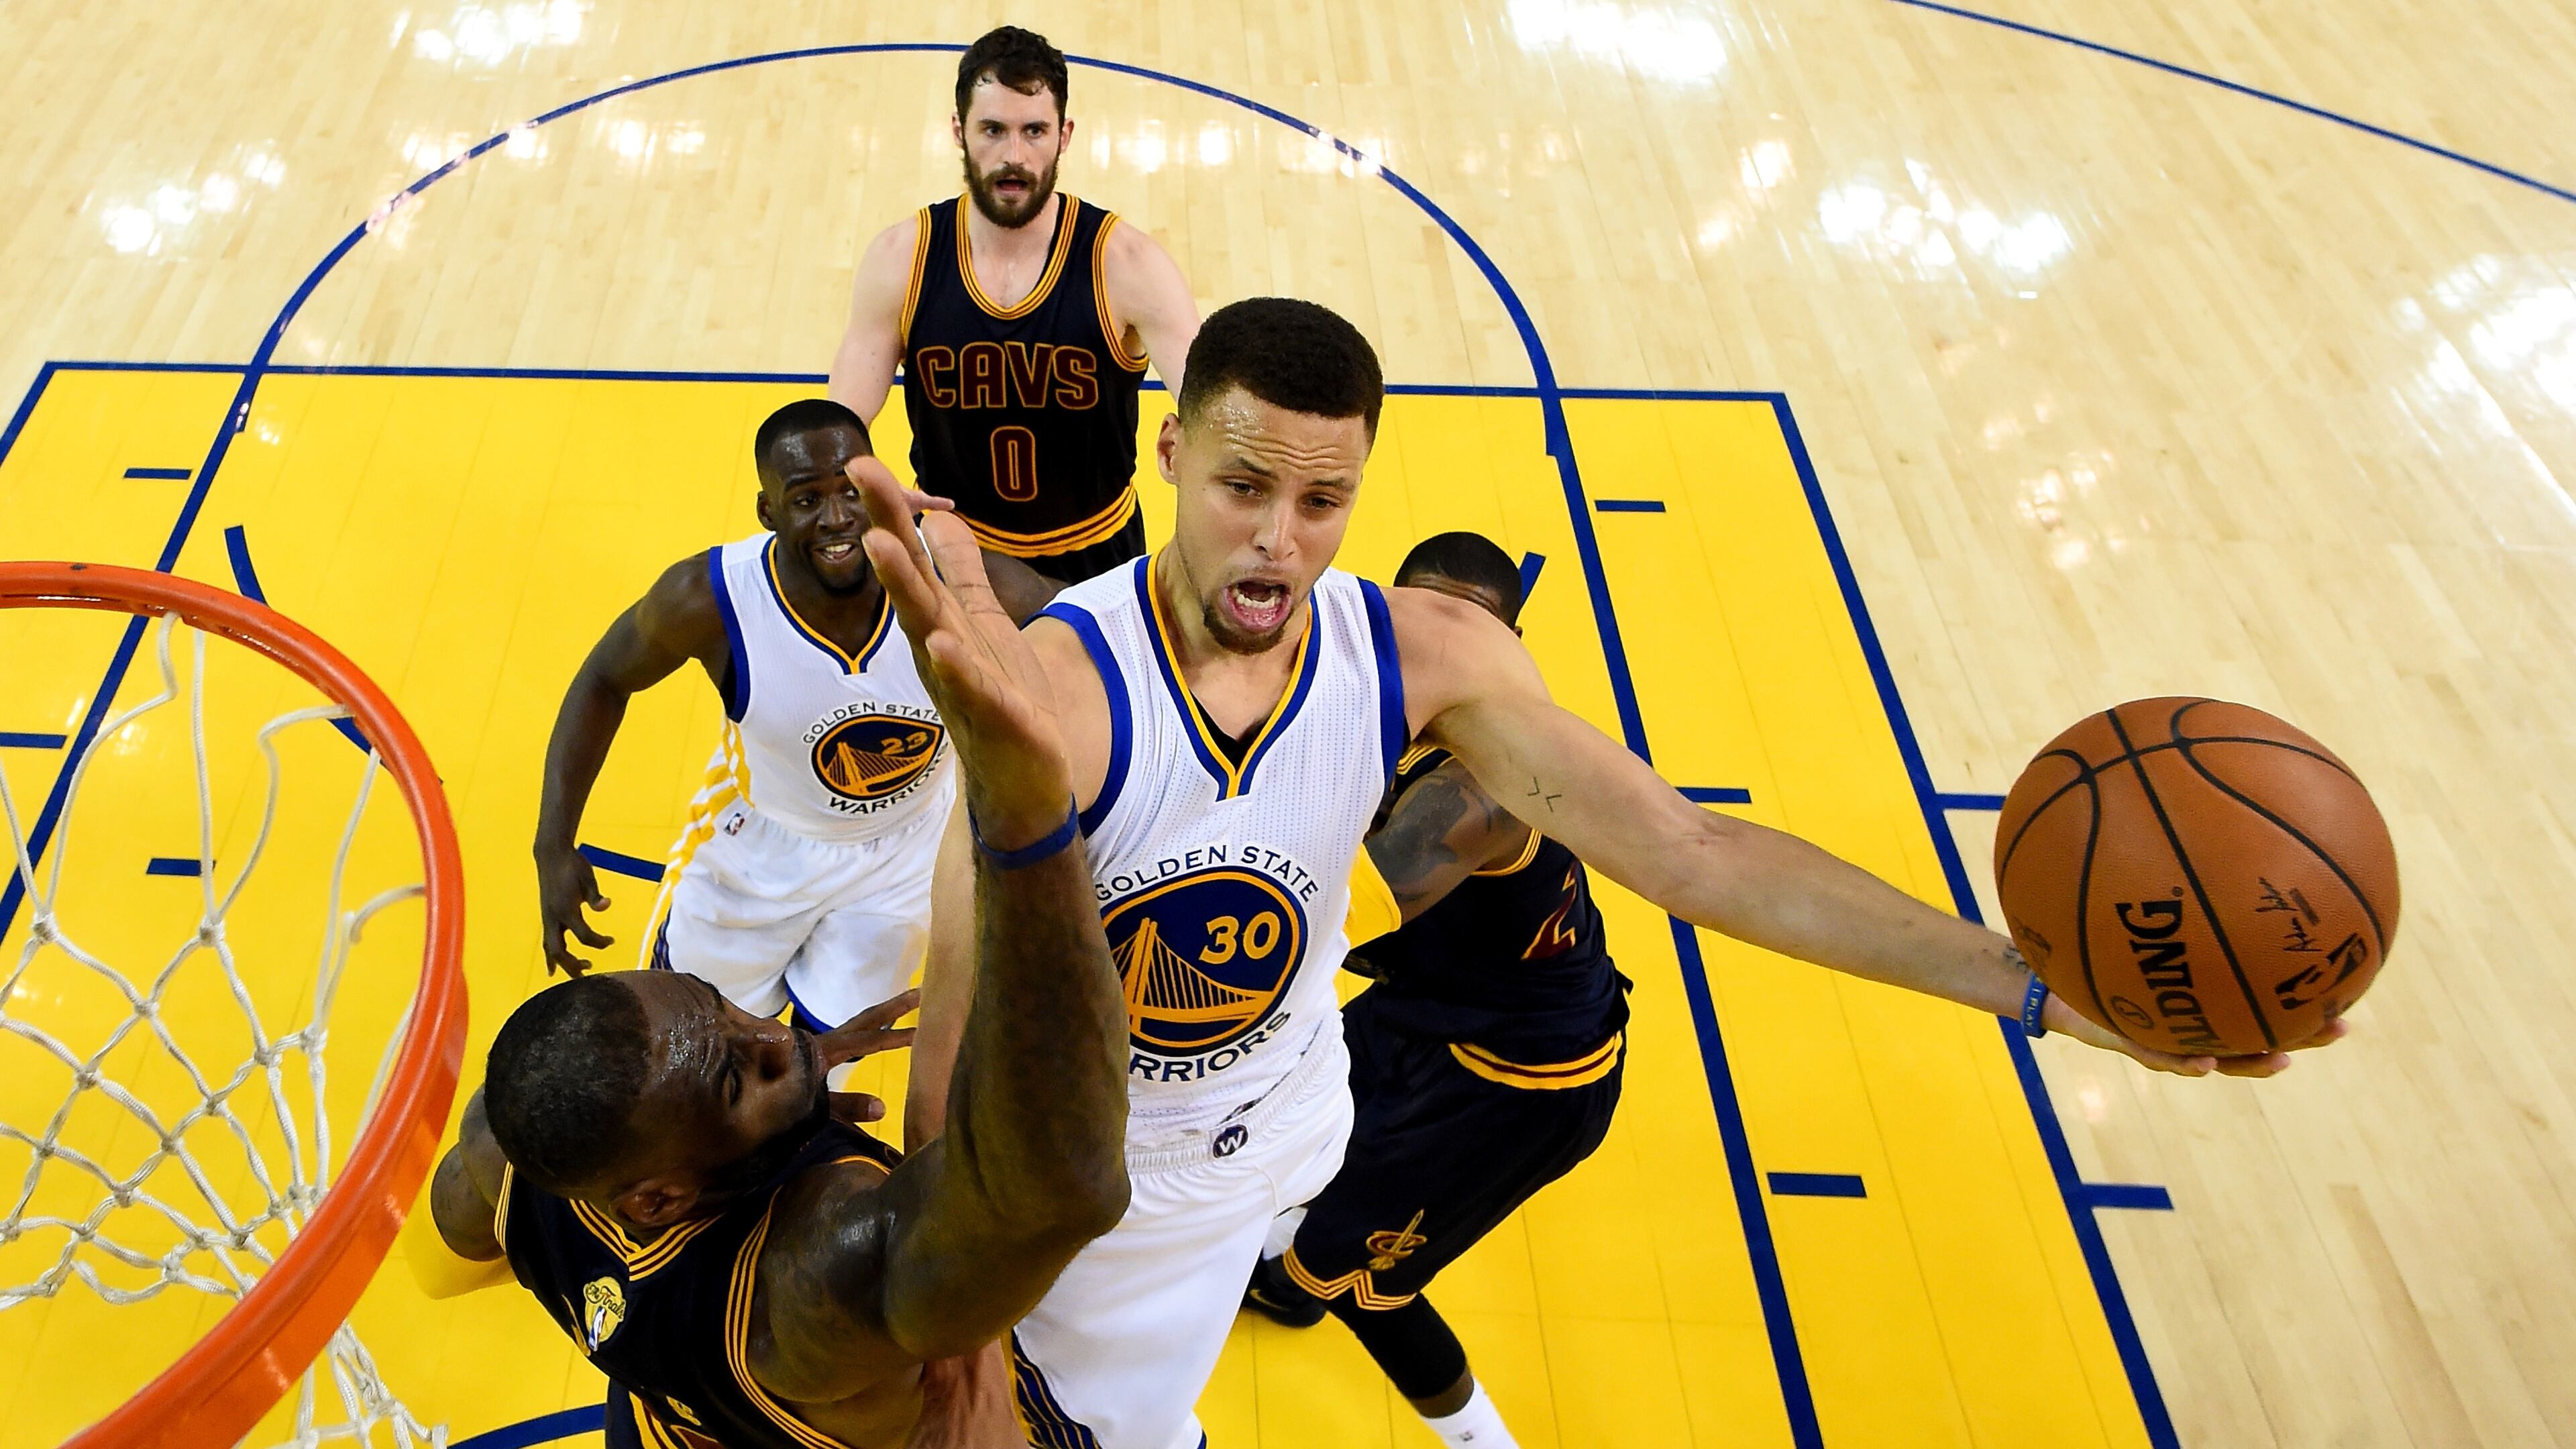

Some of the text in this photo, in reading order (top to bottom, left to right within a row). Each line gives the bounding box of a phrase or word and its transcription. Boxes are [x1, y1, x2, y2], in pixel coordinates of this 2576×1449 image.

[917, 341, 1099, 410] CAVS
[990, 426, 1038, 501] 0
[803, 702, 939, 744] GOLDEN STATE
[881, 731, 928, 756] 23
[1095, 845, 1319, 903] GOLDEN STATE
[1199, 911, 1281, 965] 30
[2115, 900, 2230, 1051] ALDING
[1129, 1012, 1291, 1081] RRIORS
[1219, 1130, 1244, 1154] W
